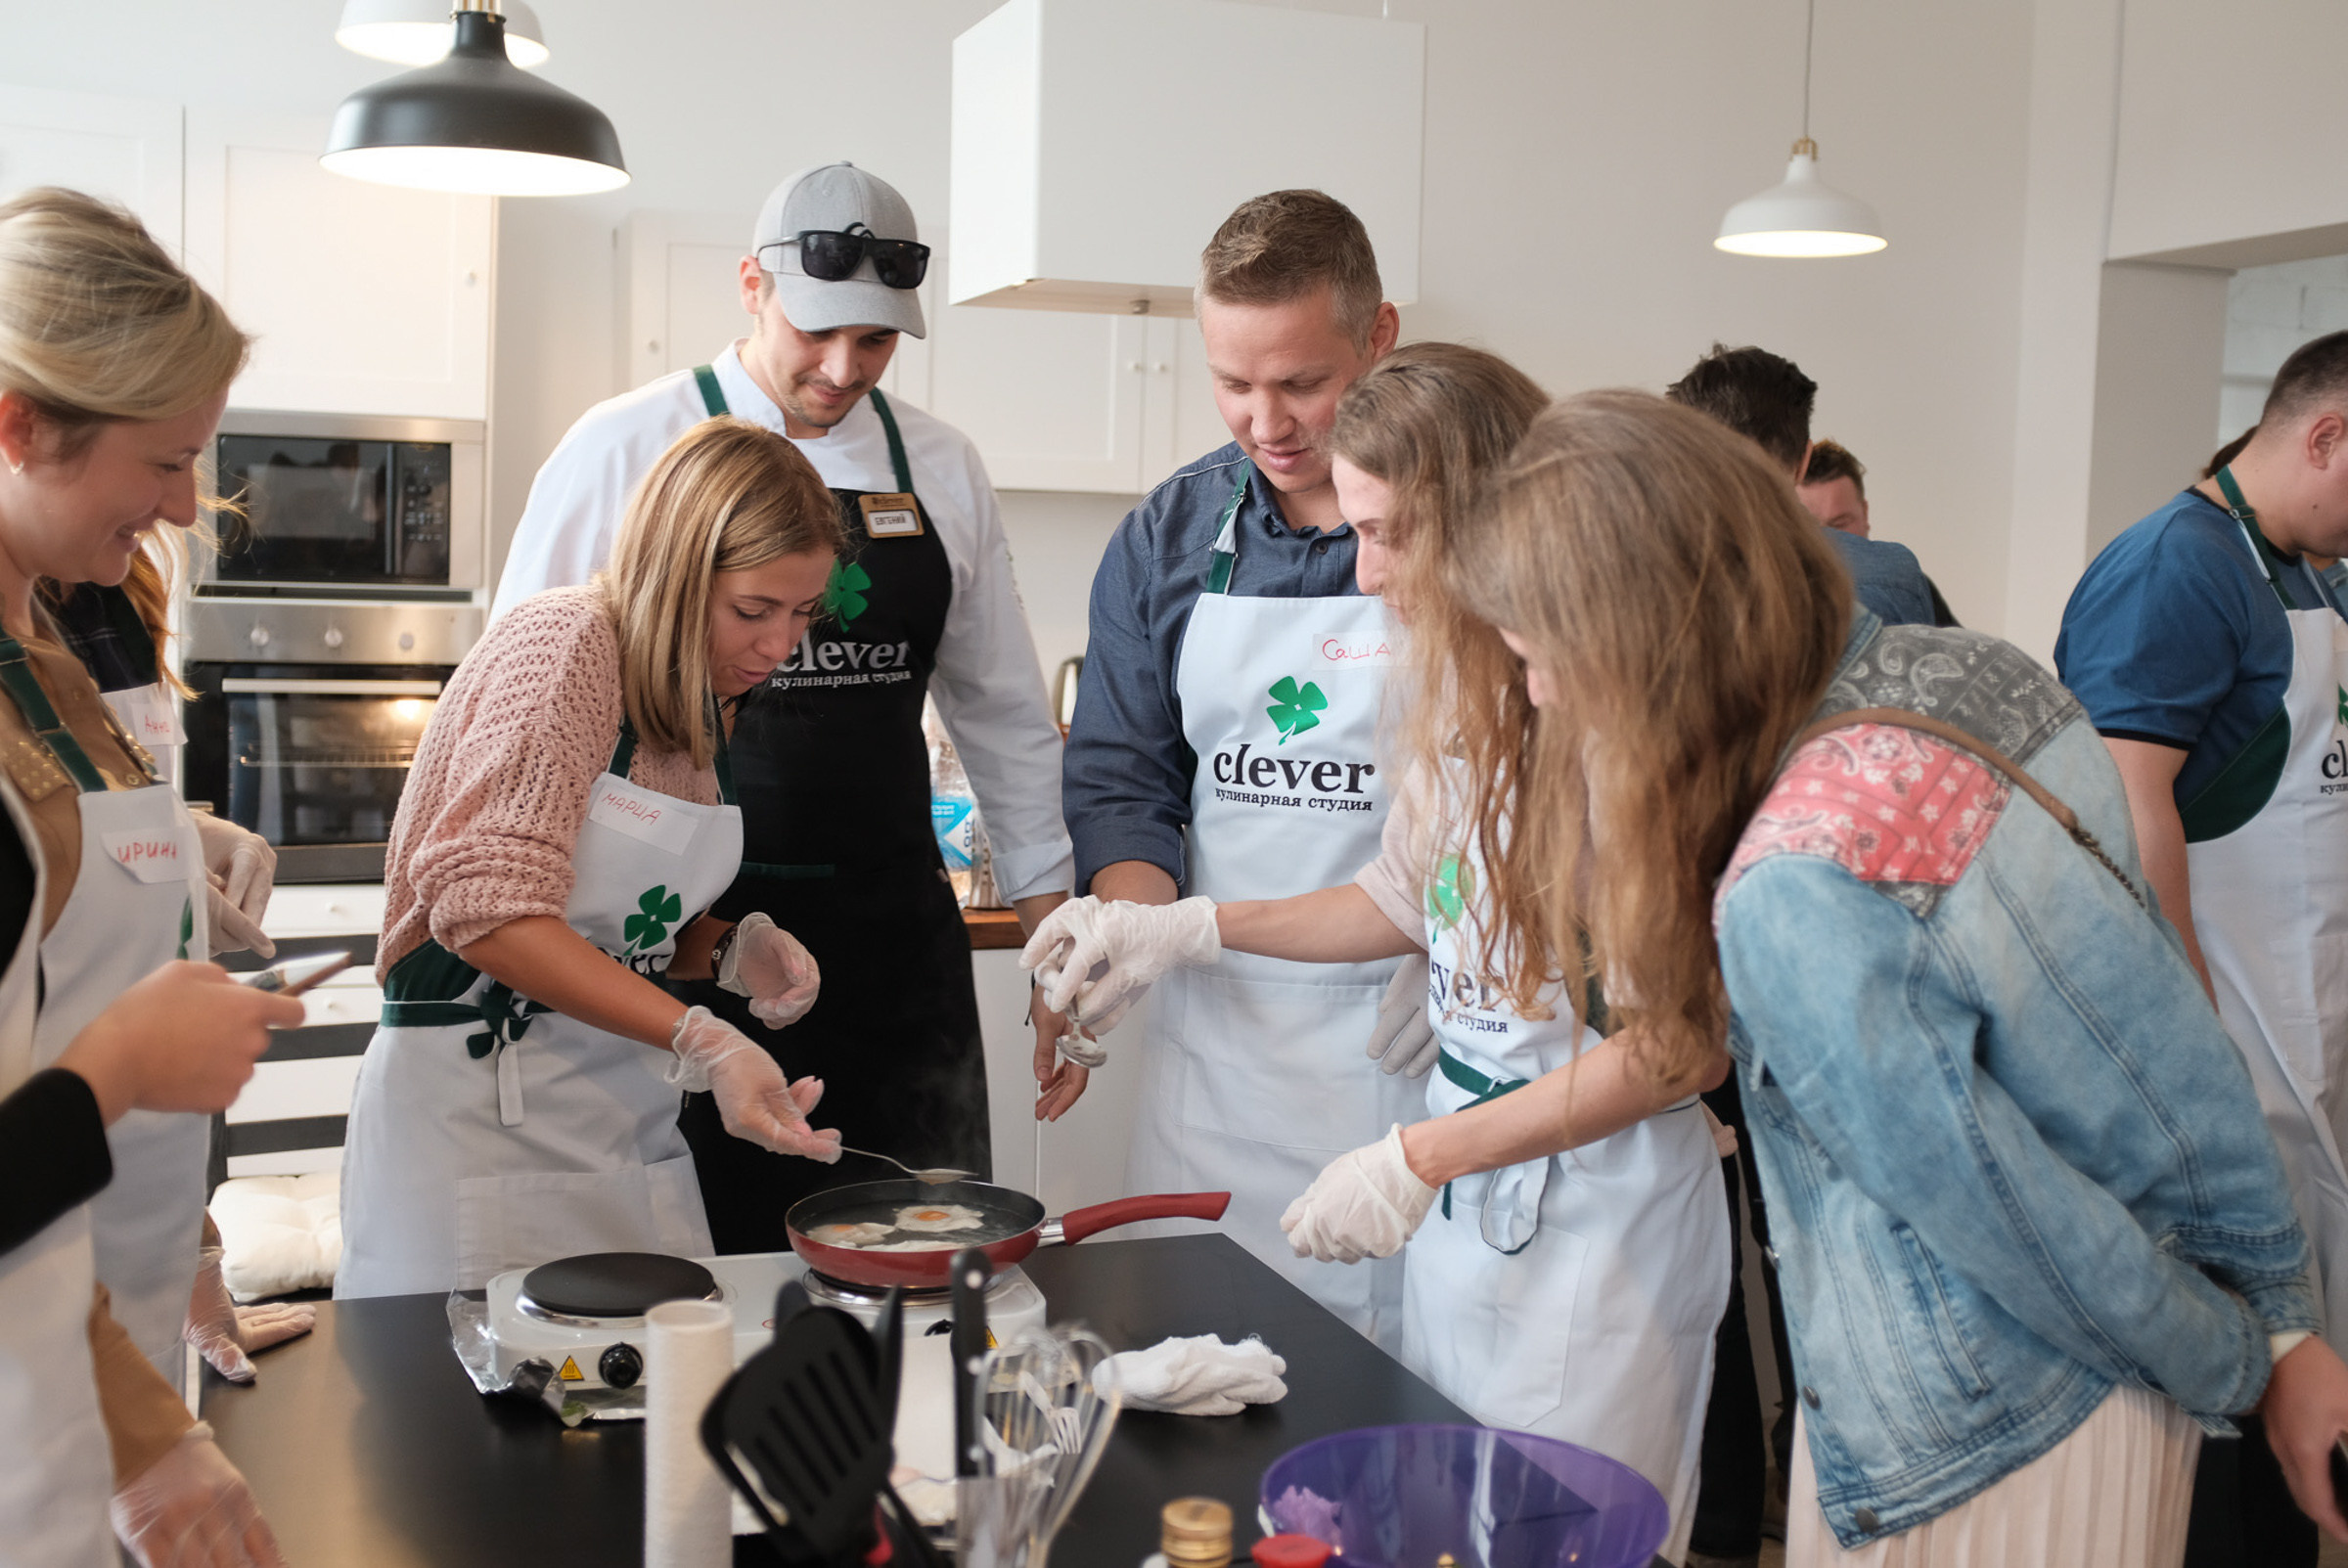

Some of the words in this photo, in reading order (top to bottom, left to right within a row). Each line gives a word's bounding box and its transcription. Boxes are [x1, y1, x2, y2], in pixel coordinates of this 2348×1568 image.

[771, 673, 870, 691] кулинарная
[1213, 743, 1376, 794] clever
[1215, 786, 1302, 808] кулинарная
[1308, 796, 1374, 812] студия
